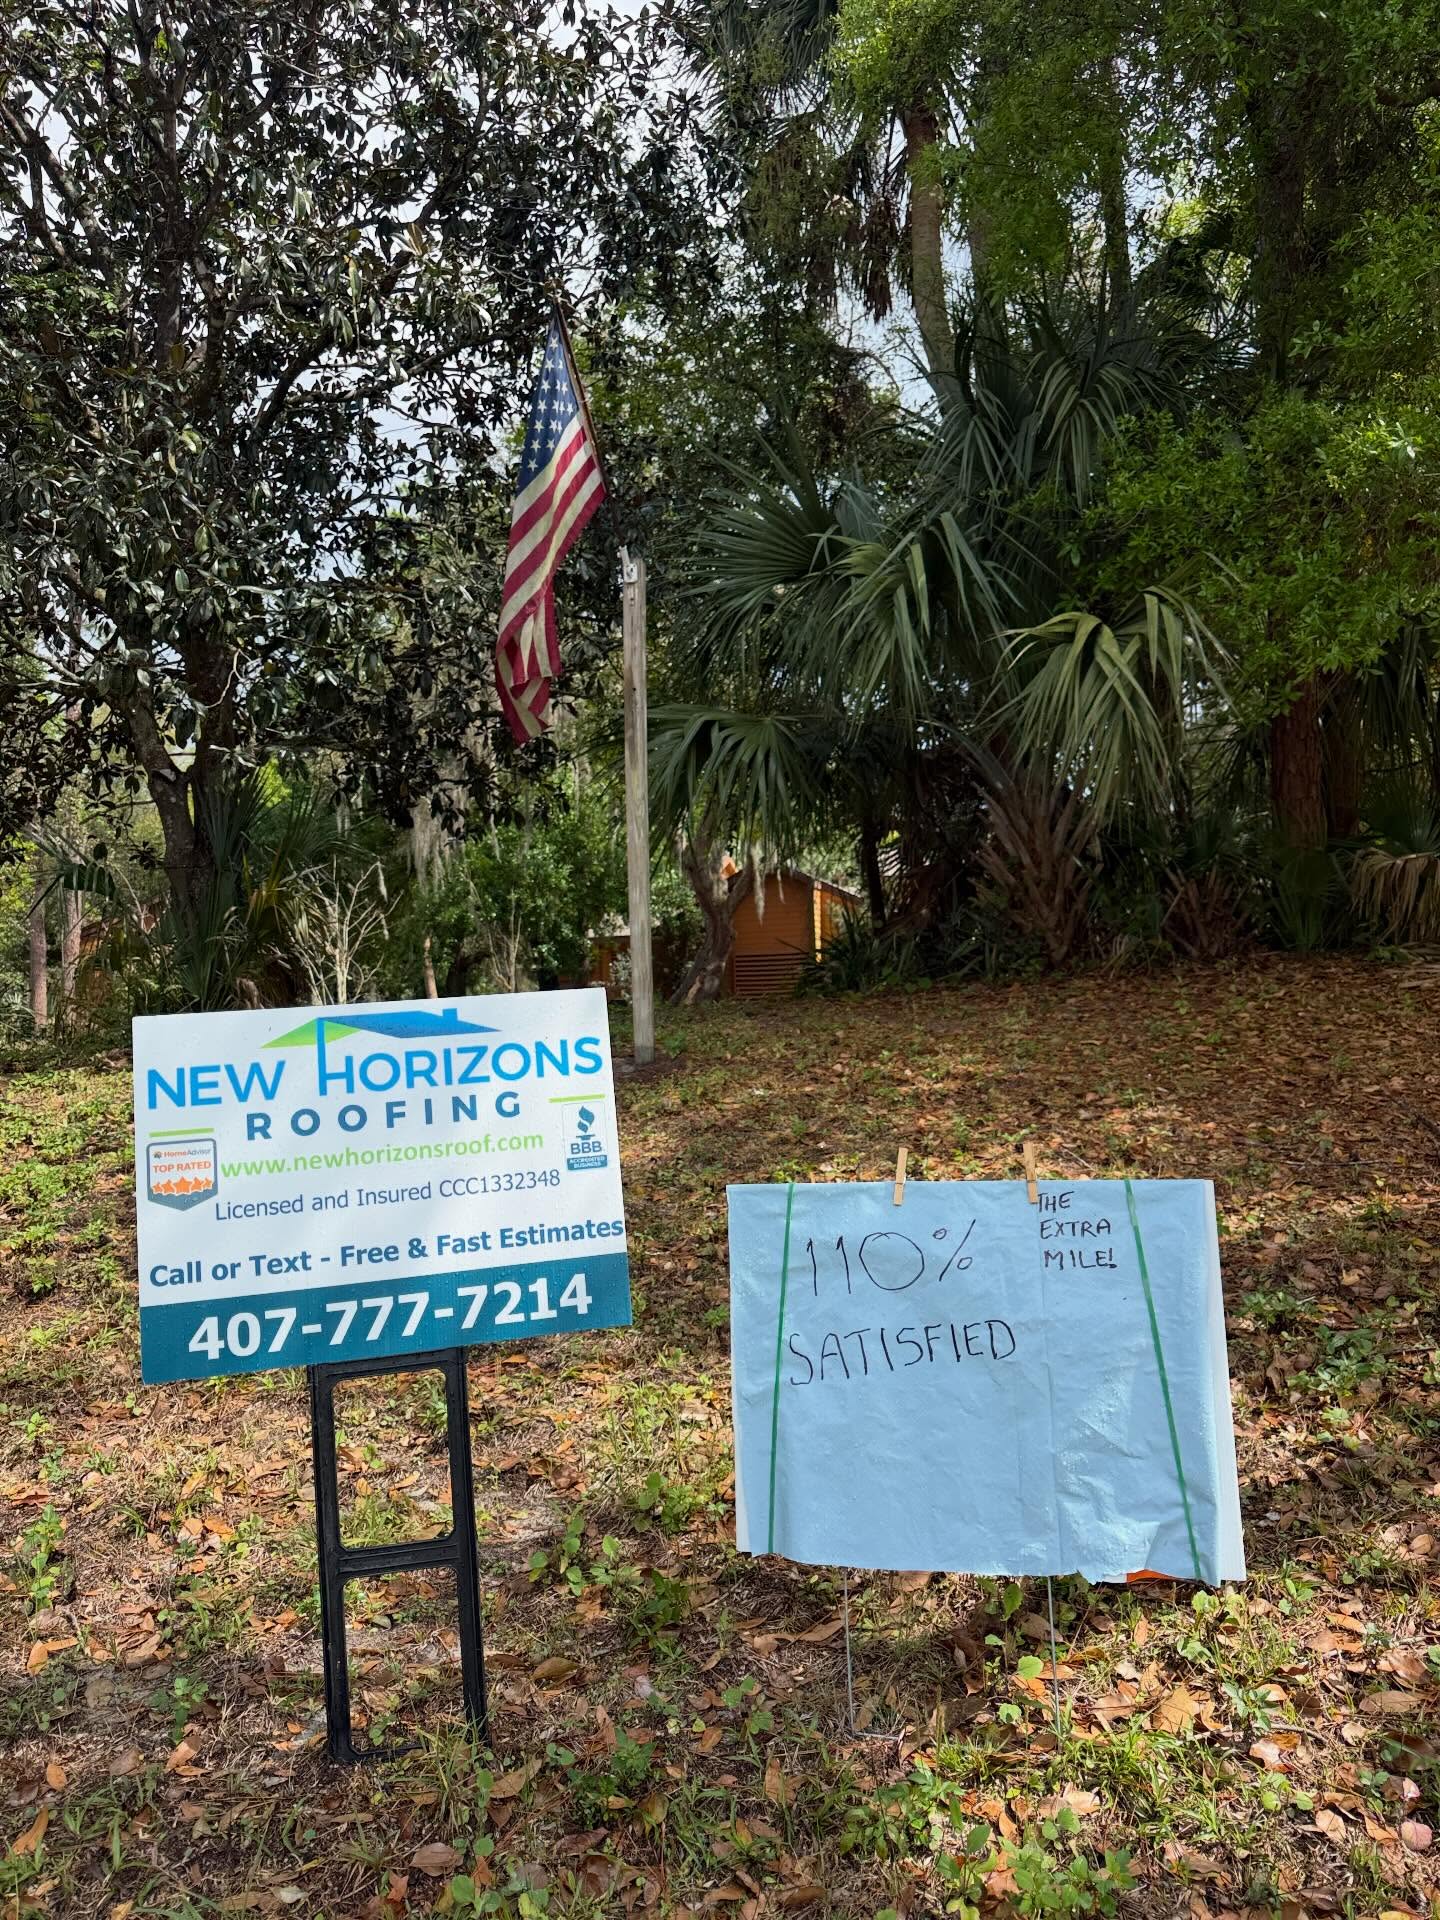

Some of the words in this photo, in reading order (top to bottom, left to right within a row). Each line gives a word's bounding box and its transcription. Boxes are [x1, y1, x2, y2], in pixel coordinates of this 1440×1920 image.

[147, 1060, 286, 1110] NEW
[317, 1018, 603, 1096] HORIZONS
[246, 1091, 521, 1141] ROOFING
[153, 1164, 175, 1173] TOP
[176, 1160, 211, 1171] RATED
[221, 1132, 544, 1178] www.newhorizonsroof.com
[571, 1141, 602, 1154] BBB
[215, 1194, 304, 1220] Licensed
[312, 1188, 348, 1212] and
[358, 1181, 432, 1206] Insured
[439, 1169, 560, 1198] CCC1332348
[1037, 1191, 1074, 1213] THE
[150, 1262, 201, 1287] Call
[211, 1261, 241, 1281] or
[249, 1251, 311, 1277] Text
[341, 1244, 400, 1268] Free
[408, 1239, 426, 1259] &
[437, 1229, 490, 1255] Fast
[500, 1216, 624, 1248] Estimates
[1040, 1219, 1111, 1238] EXTRA
[1043, 1248, 1117, 1270] MILE!
[188, 1273, 593, 1360] 407-777-7214
[790, 1320, 1016, 1385] SATISFIED
